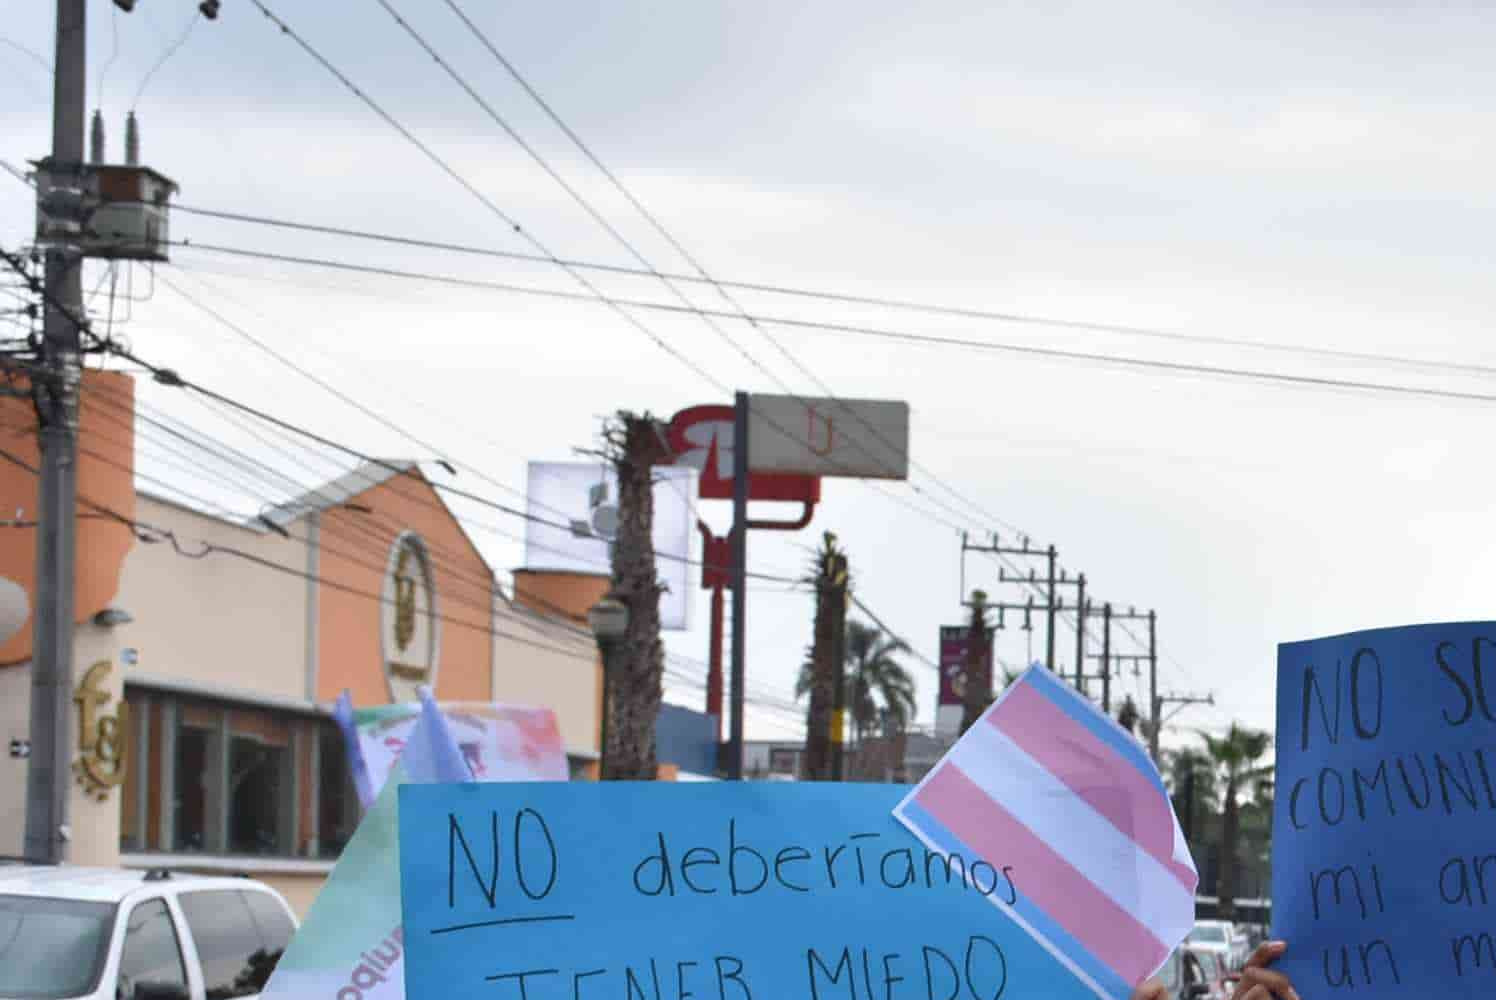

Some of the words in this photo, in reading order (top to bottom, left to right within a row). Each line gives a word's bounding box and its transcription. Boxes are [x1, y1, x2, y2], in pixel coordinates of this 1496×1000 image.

[1302, 648, 1382, 752] NO
[448, 808, 556, 909] NO
[1310, 851, 1383, 920] mi
[1324, 940, 1400, 989] un
